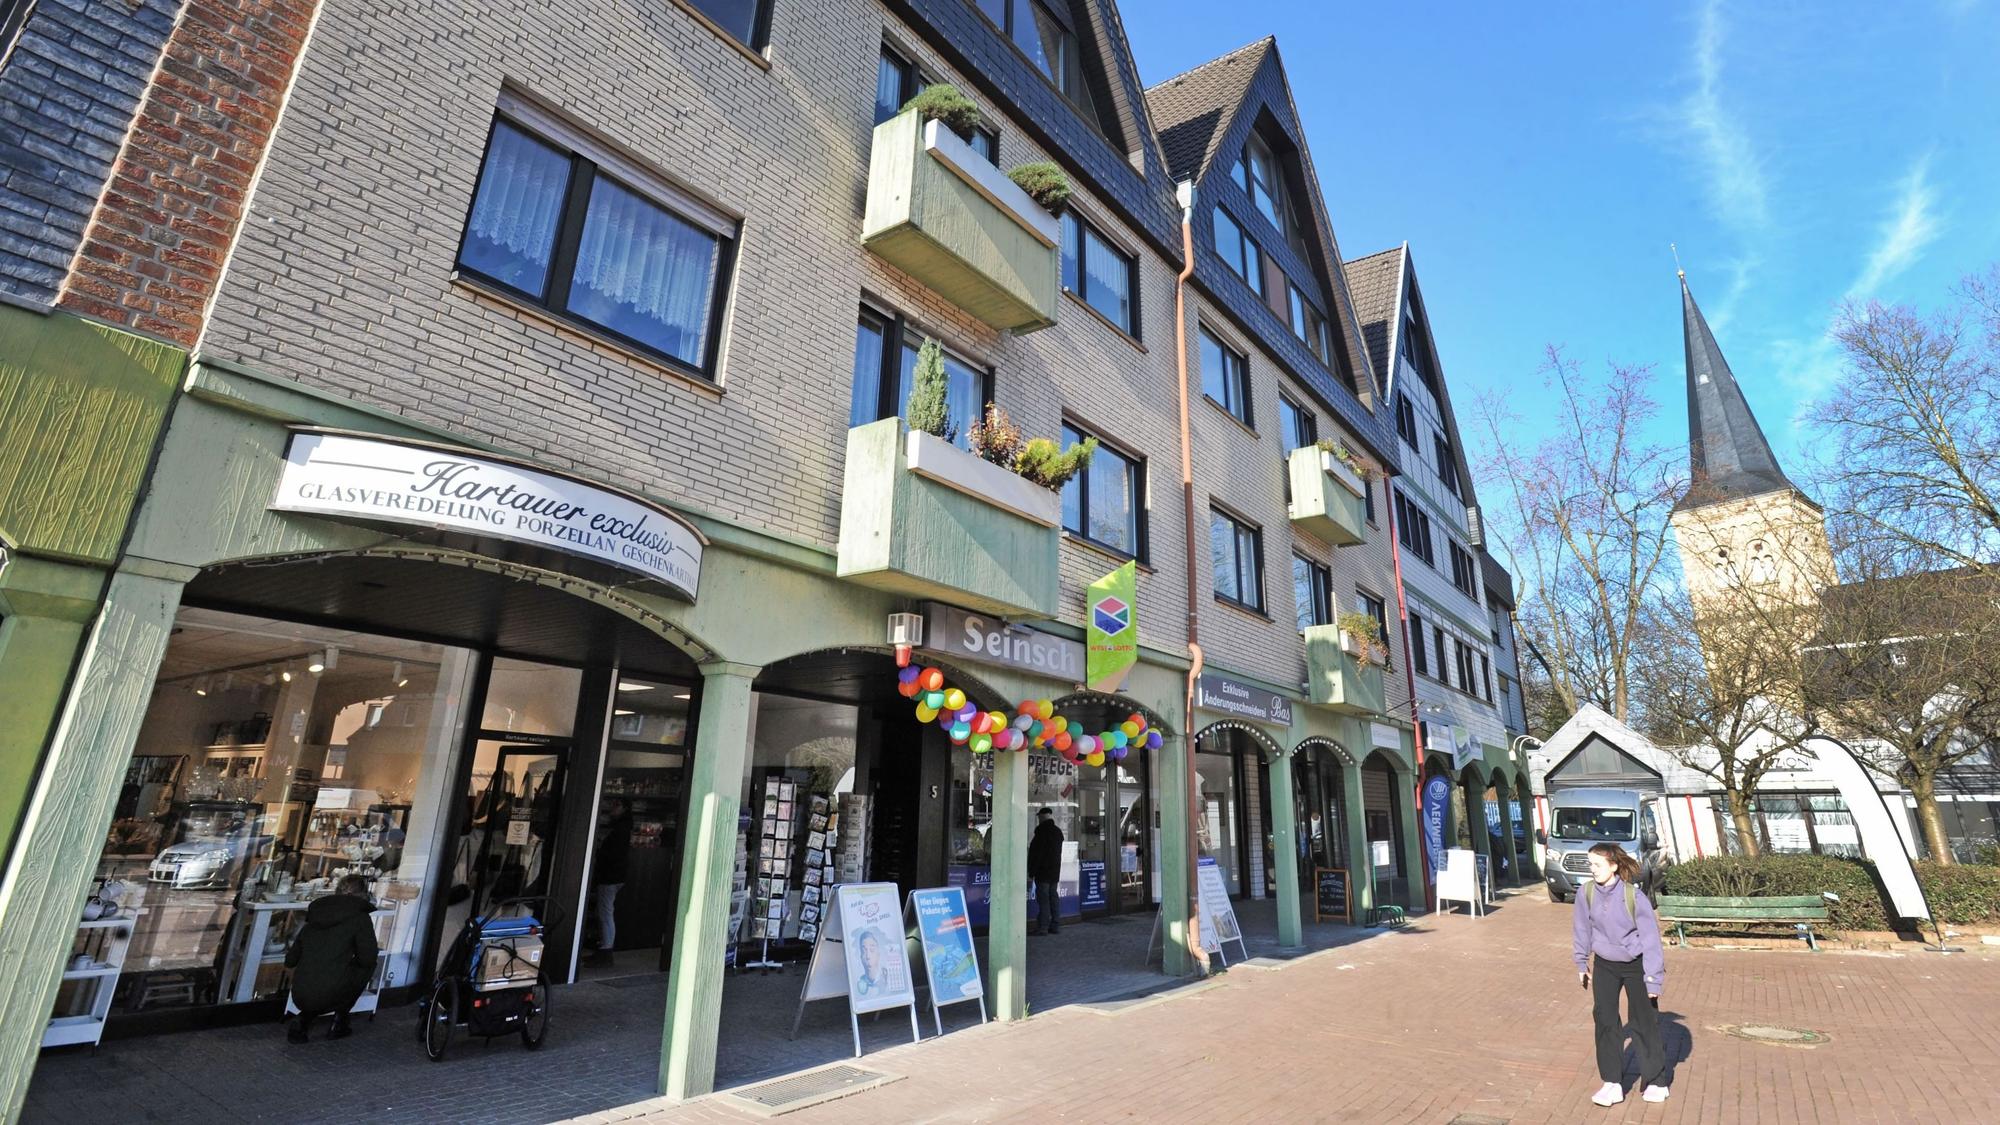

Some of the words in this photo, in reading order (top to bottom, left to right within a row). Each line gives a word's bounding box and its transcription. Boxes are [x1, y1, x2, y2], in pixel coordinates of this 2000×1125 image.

[298, 482, 506, 527] GLASVEREDELUNG
[516, 515, 616, 554] PORZELLAN
[411, 460, 586, 523] Hartauer
[590, 513, 675, 555] exclusiv
[962, 615, 1077, 675] Seinsch
[1203, 690, 1267, 718] Änderungsschneiderei
[1222, 681, 1250, 699] Exklusive
[930, 785, 938, 798] 5
